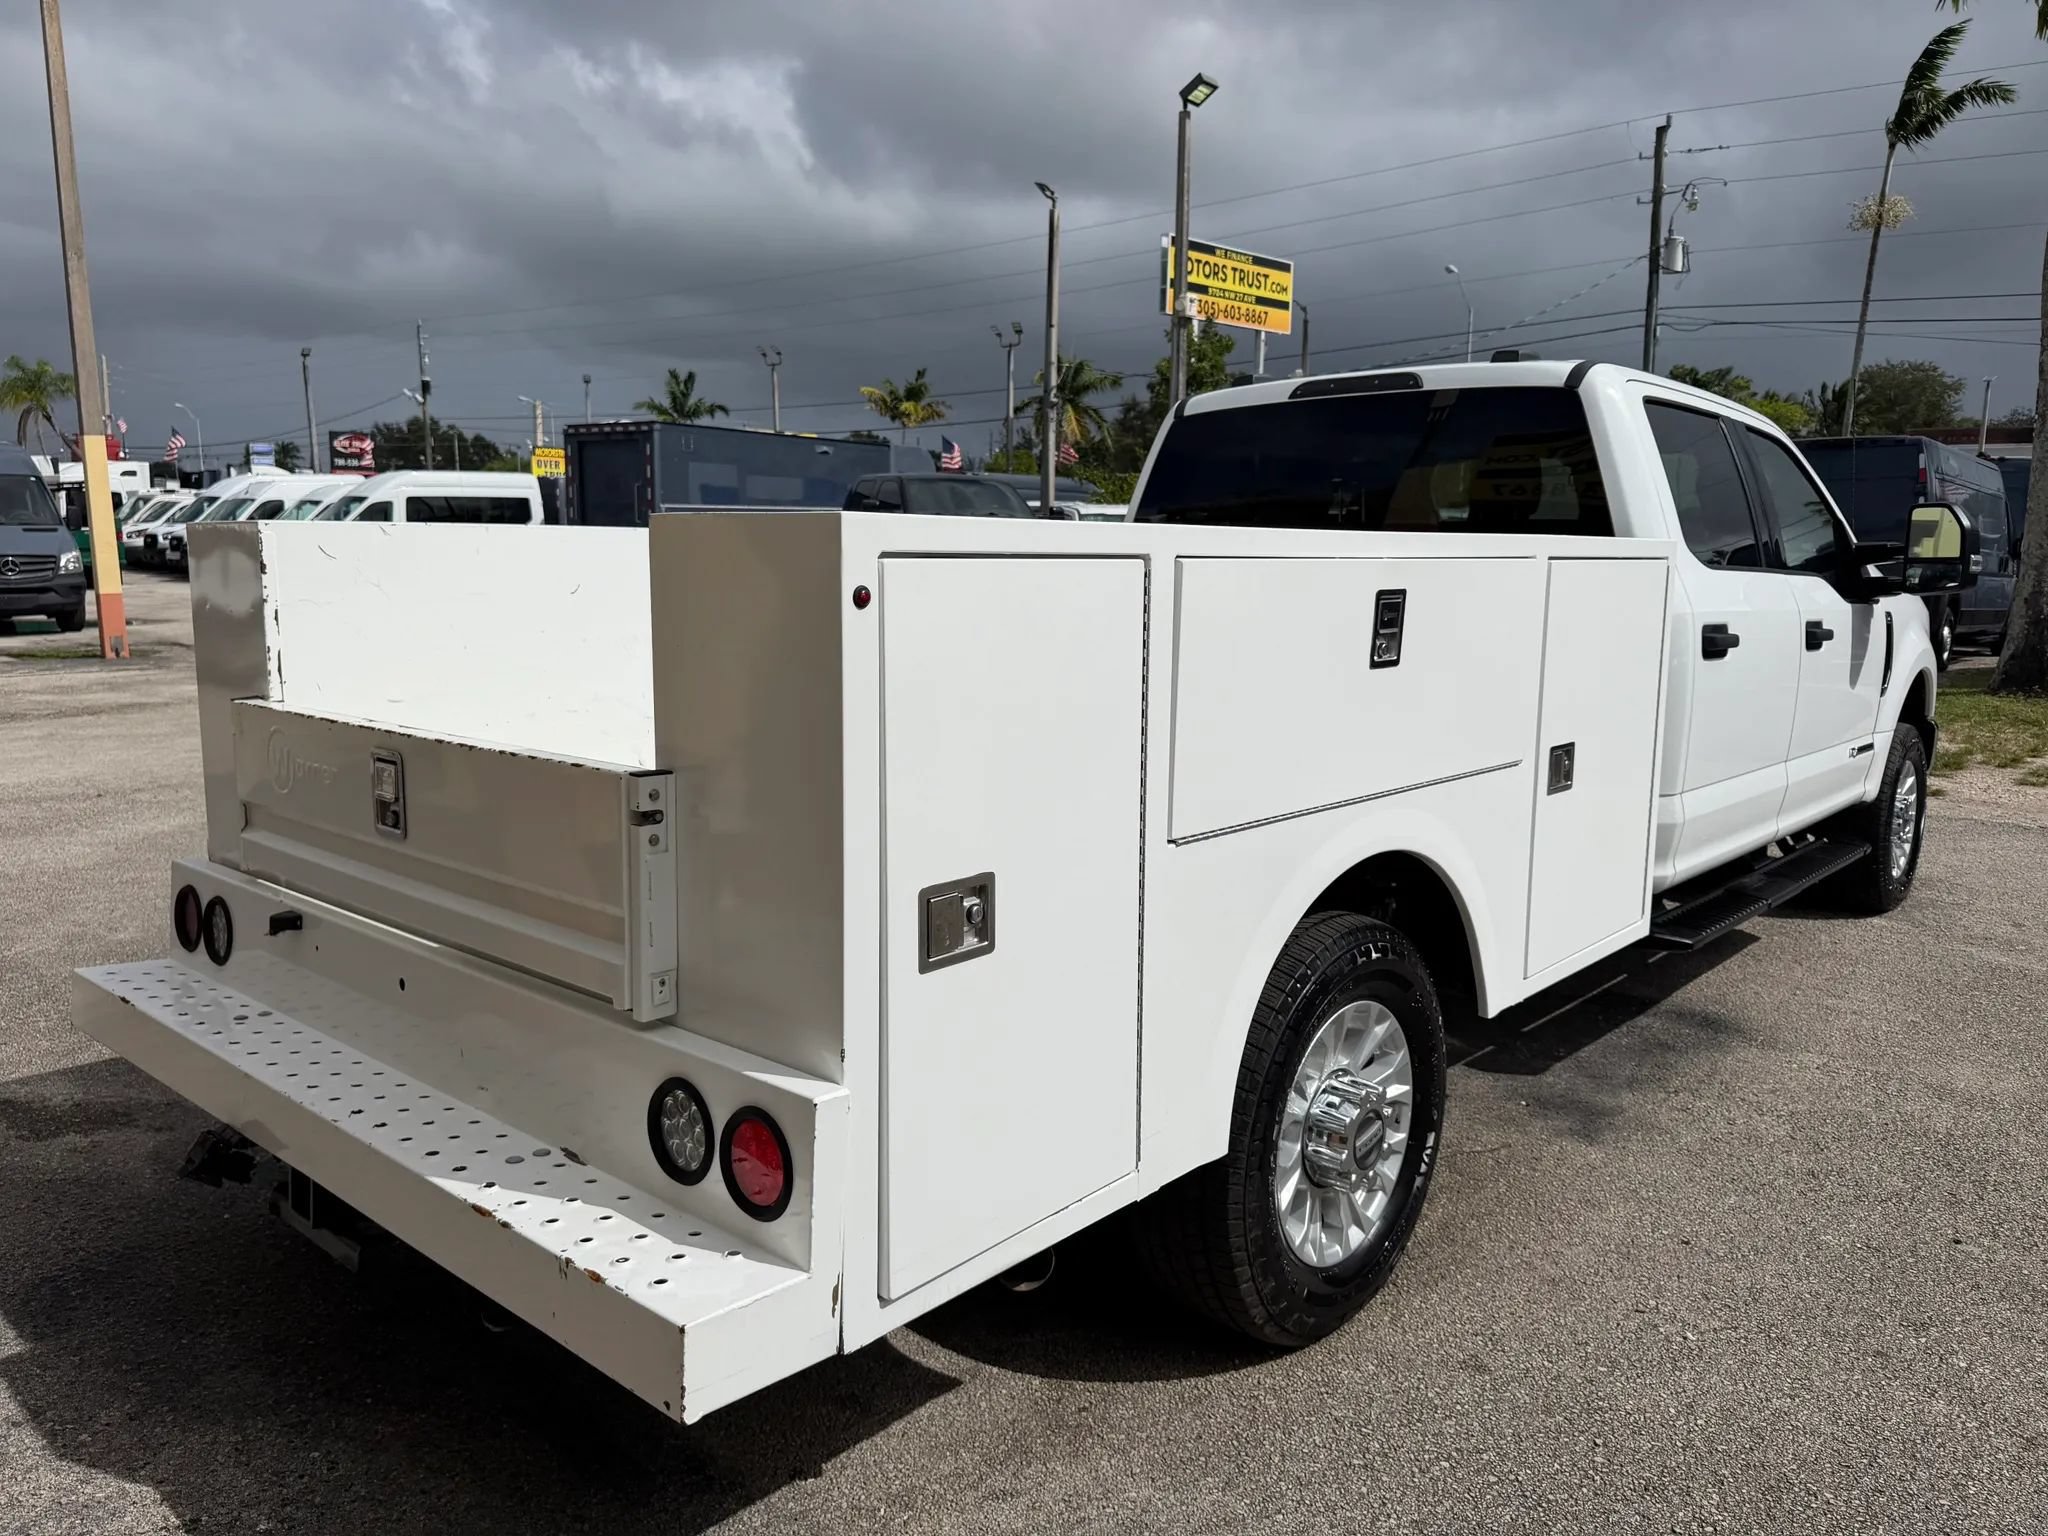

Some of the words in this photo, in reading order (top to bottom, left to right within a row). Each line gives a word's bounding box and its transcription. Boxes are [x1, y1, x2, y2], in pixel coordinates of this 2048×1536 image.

[1214, 248, 1226, 258] WE
[1227, 251, 1253, 264] FINANCE
[1187, 258, 1227, 282] OTORS
[1244, 294, 1257, 305] AVE
[1197, 299, 1268, 325] 305)-603-8867
[536, 458, 561, 470] OVER
